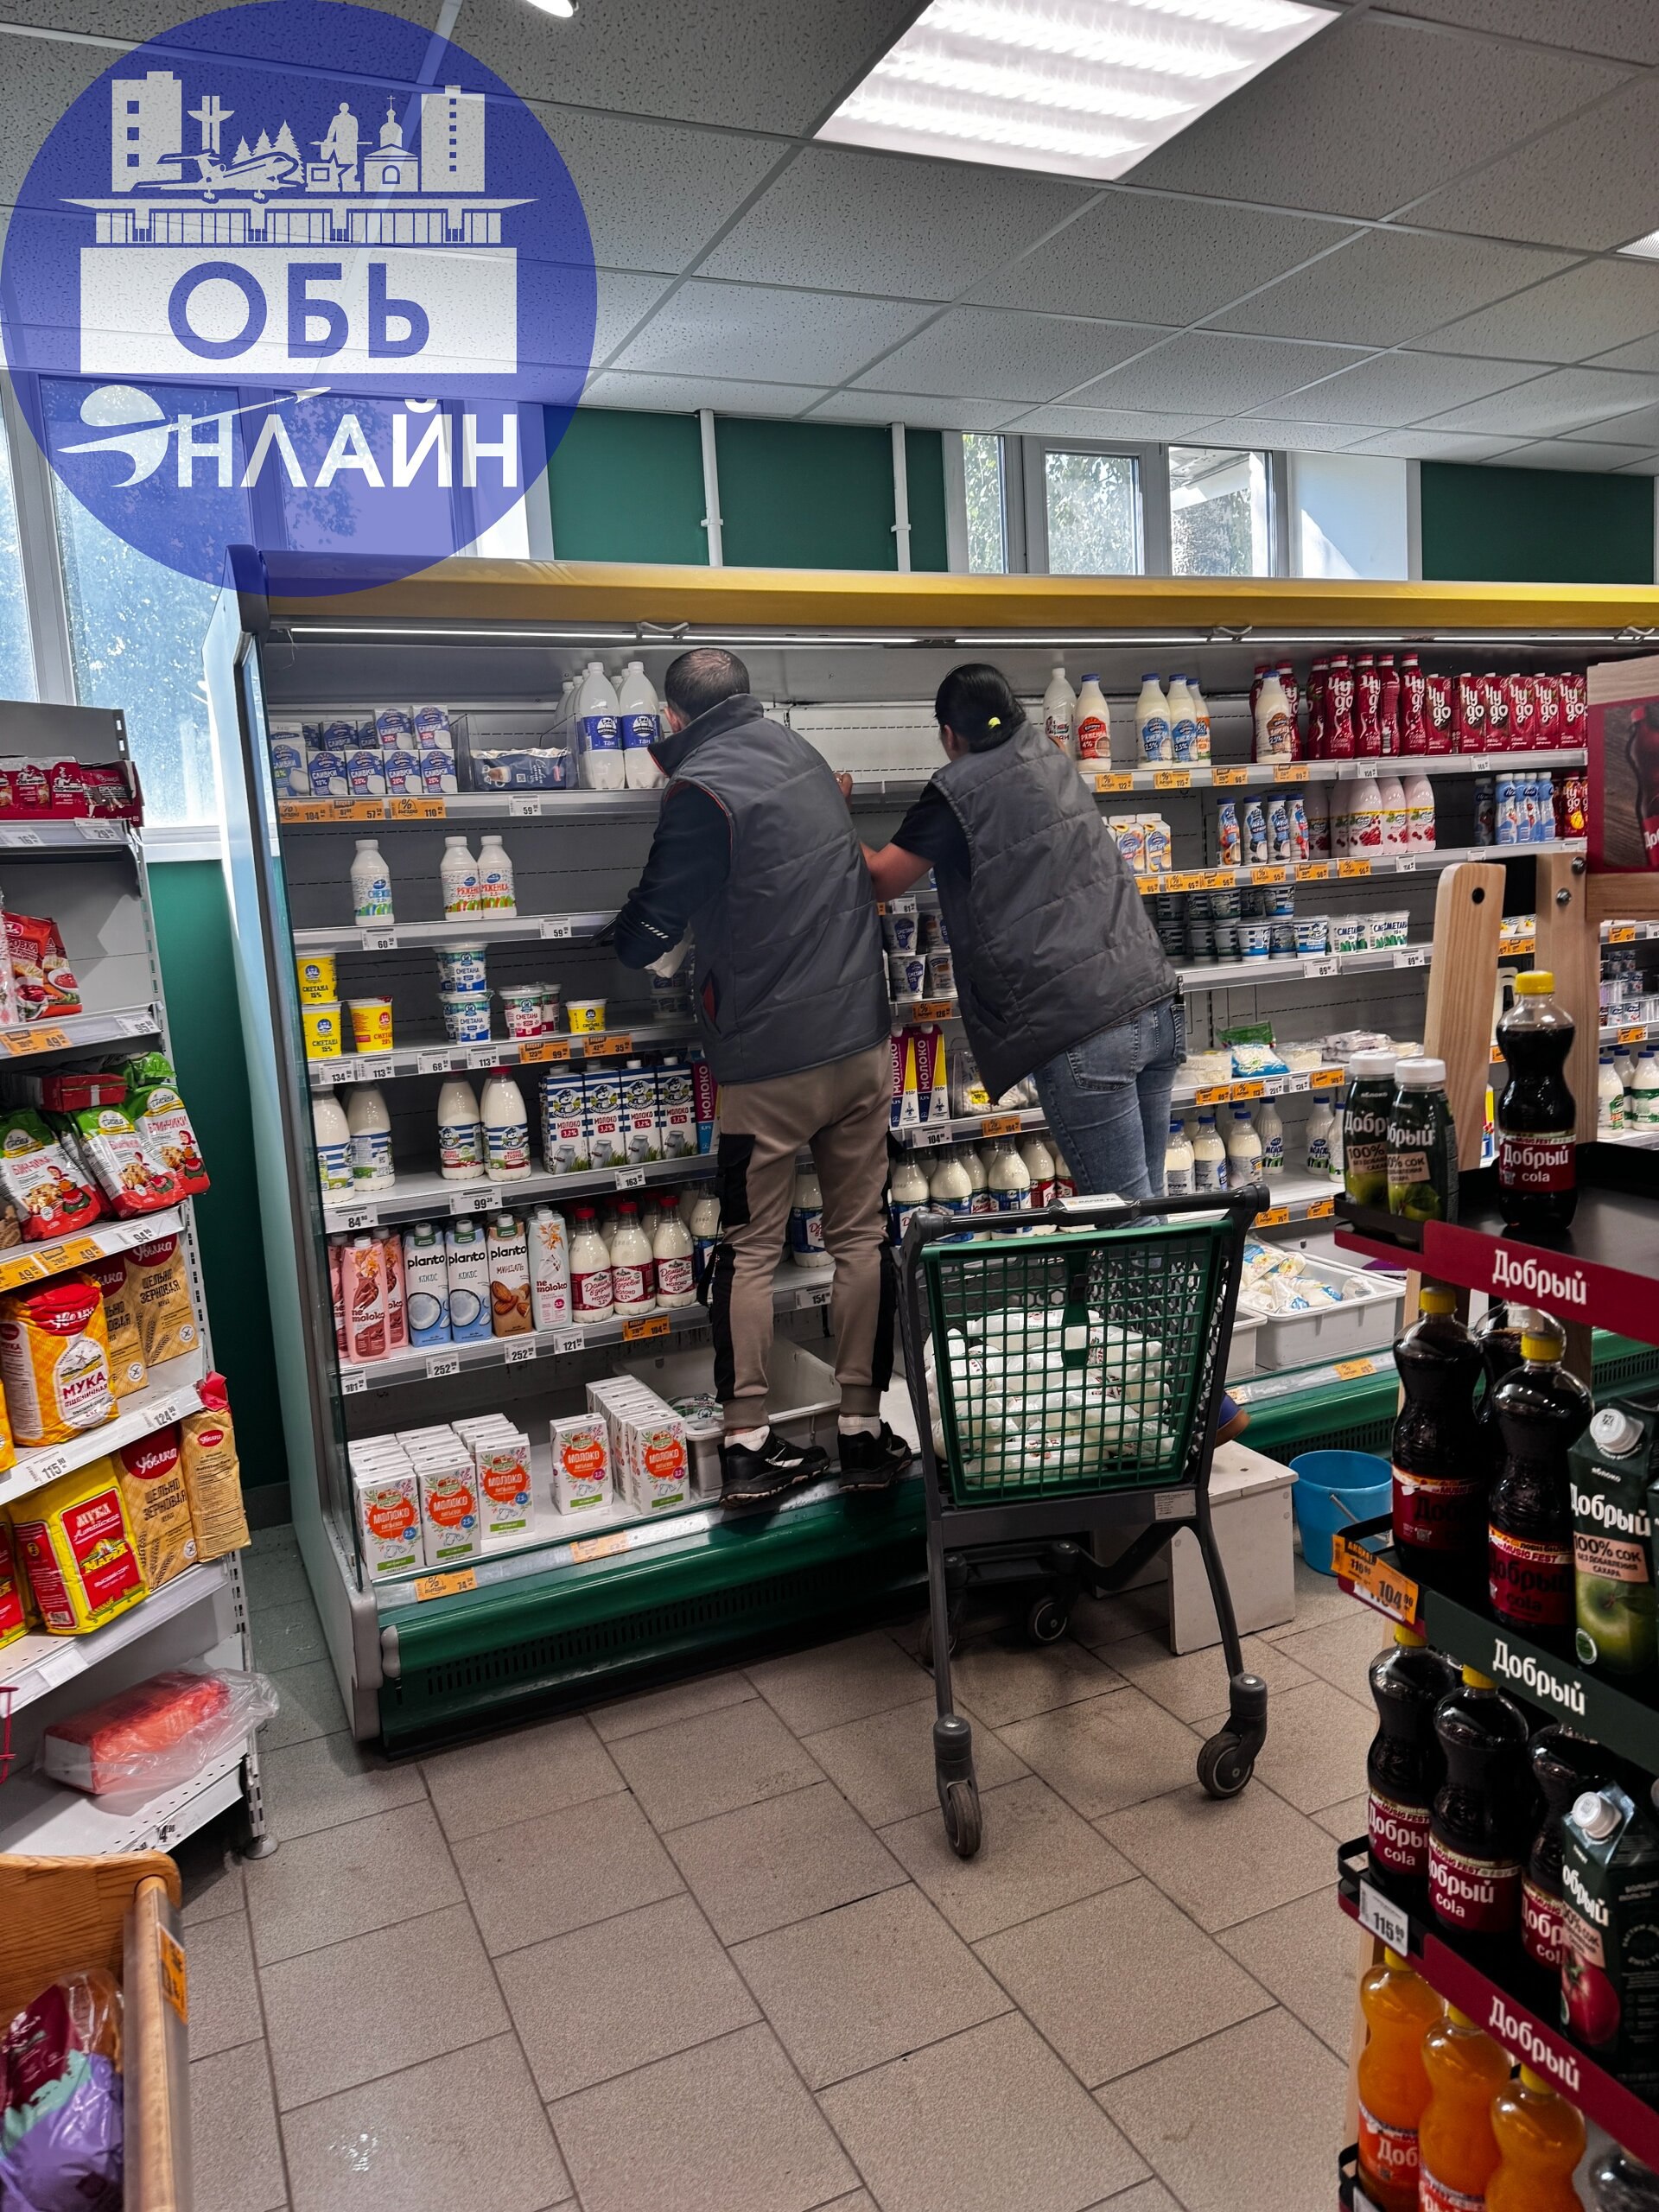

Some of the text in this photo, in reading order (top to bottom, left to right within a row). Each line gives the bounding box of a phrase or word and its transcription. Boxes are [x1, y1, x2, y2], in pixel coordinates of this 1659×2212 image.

[523, 806, 533, 815] 59
[378, 940, 388, 949] 60
[135, 1024, 148, 1033] 95
[46, 1037, 60, 1047] 49
[552, 1050, 562, 1058] 99
[892, 1044, 902, 1094] МОЛОКО
[918, 1039, 931, 1090] МОЛОКО
[699, 1065, 712, 1119] МОЛОКО
[631, 1111, 653, 1120] МОЛОКО
[666, 1107, 690, 1116] МОЛОКО
[557, 1120, 581, 1129] МОЛОКО
[594, 1116, 617, 1124] МОЛОКО
[1344, 1110, 1387, 1136] Добр
[927, 1134, 941, 1144] 104
[1503, 1144, 1569, 1169] Добрый
[625, 1177, 638, 1186] 163
[1522, 1171, 1550, 1182] cola
[474, 1198, 486, 1210] 99
[348, 1217, 360, 1228] 84
[133, 1231, 146, 1243] 94
[80, 1249, 93, 1260] 49
[448, 1251, 486, 1266] planto
[490, 1245, 527, 1261] planto
[407, 1254, 446, 1269] planto
[18, 1271, 32, 1281] 49
[1492, 1249, 1589, 1305] Добрый
[537, 1281, 568, 1293] moloko
[352, 1312, 385, 1323] moloko
[563, 1340, 576, 1351] 121
[512, 1350, 528, 1361] 252
[434, 1364, 451, 1377] 252
[62, 1371, 107, 1399] МУКА
[154, 1411, 169, 1426] 124
[568, 1449, 600, 1464] МОЛОКО
[649, 1449, 679, 1464] МОЛОКО
[41, 1463, 61, 1478] 115
[1592, 1467, 1621, 1483] яблоко
[488, 1473, 522, 1488] МОЛОКО
[434, 1496, 467, 1511] МОЛОКО
[1570, 1483, 1651, 1536] Добрый
[373, 1507, 410, 1525] МОЛОКО
[1503, 1543, 1558, 1562] MUSIC FEST
[1574, 1535, 1613, 1557] 100%
[1589, 1555, 1638, 1571] ДОБАВЛЕНИЯ
[1593, 1565, 1621, 1578] САХАРА
[1379, 1581, 1414, 1609] 104 90
[1492, 1637, 1586, 1716] Добрый
[1369, 1802, 1428, 1848] Добры
[1384, 1847, 1415, 1866] cola
[1435, 1892, 1465, 1917] cola
[1373, 1910, 1395, 1942] 115
[1536, 1943, 1560, 1963] col
[1489, 1995, 1580, 2093] Добрый
